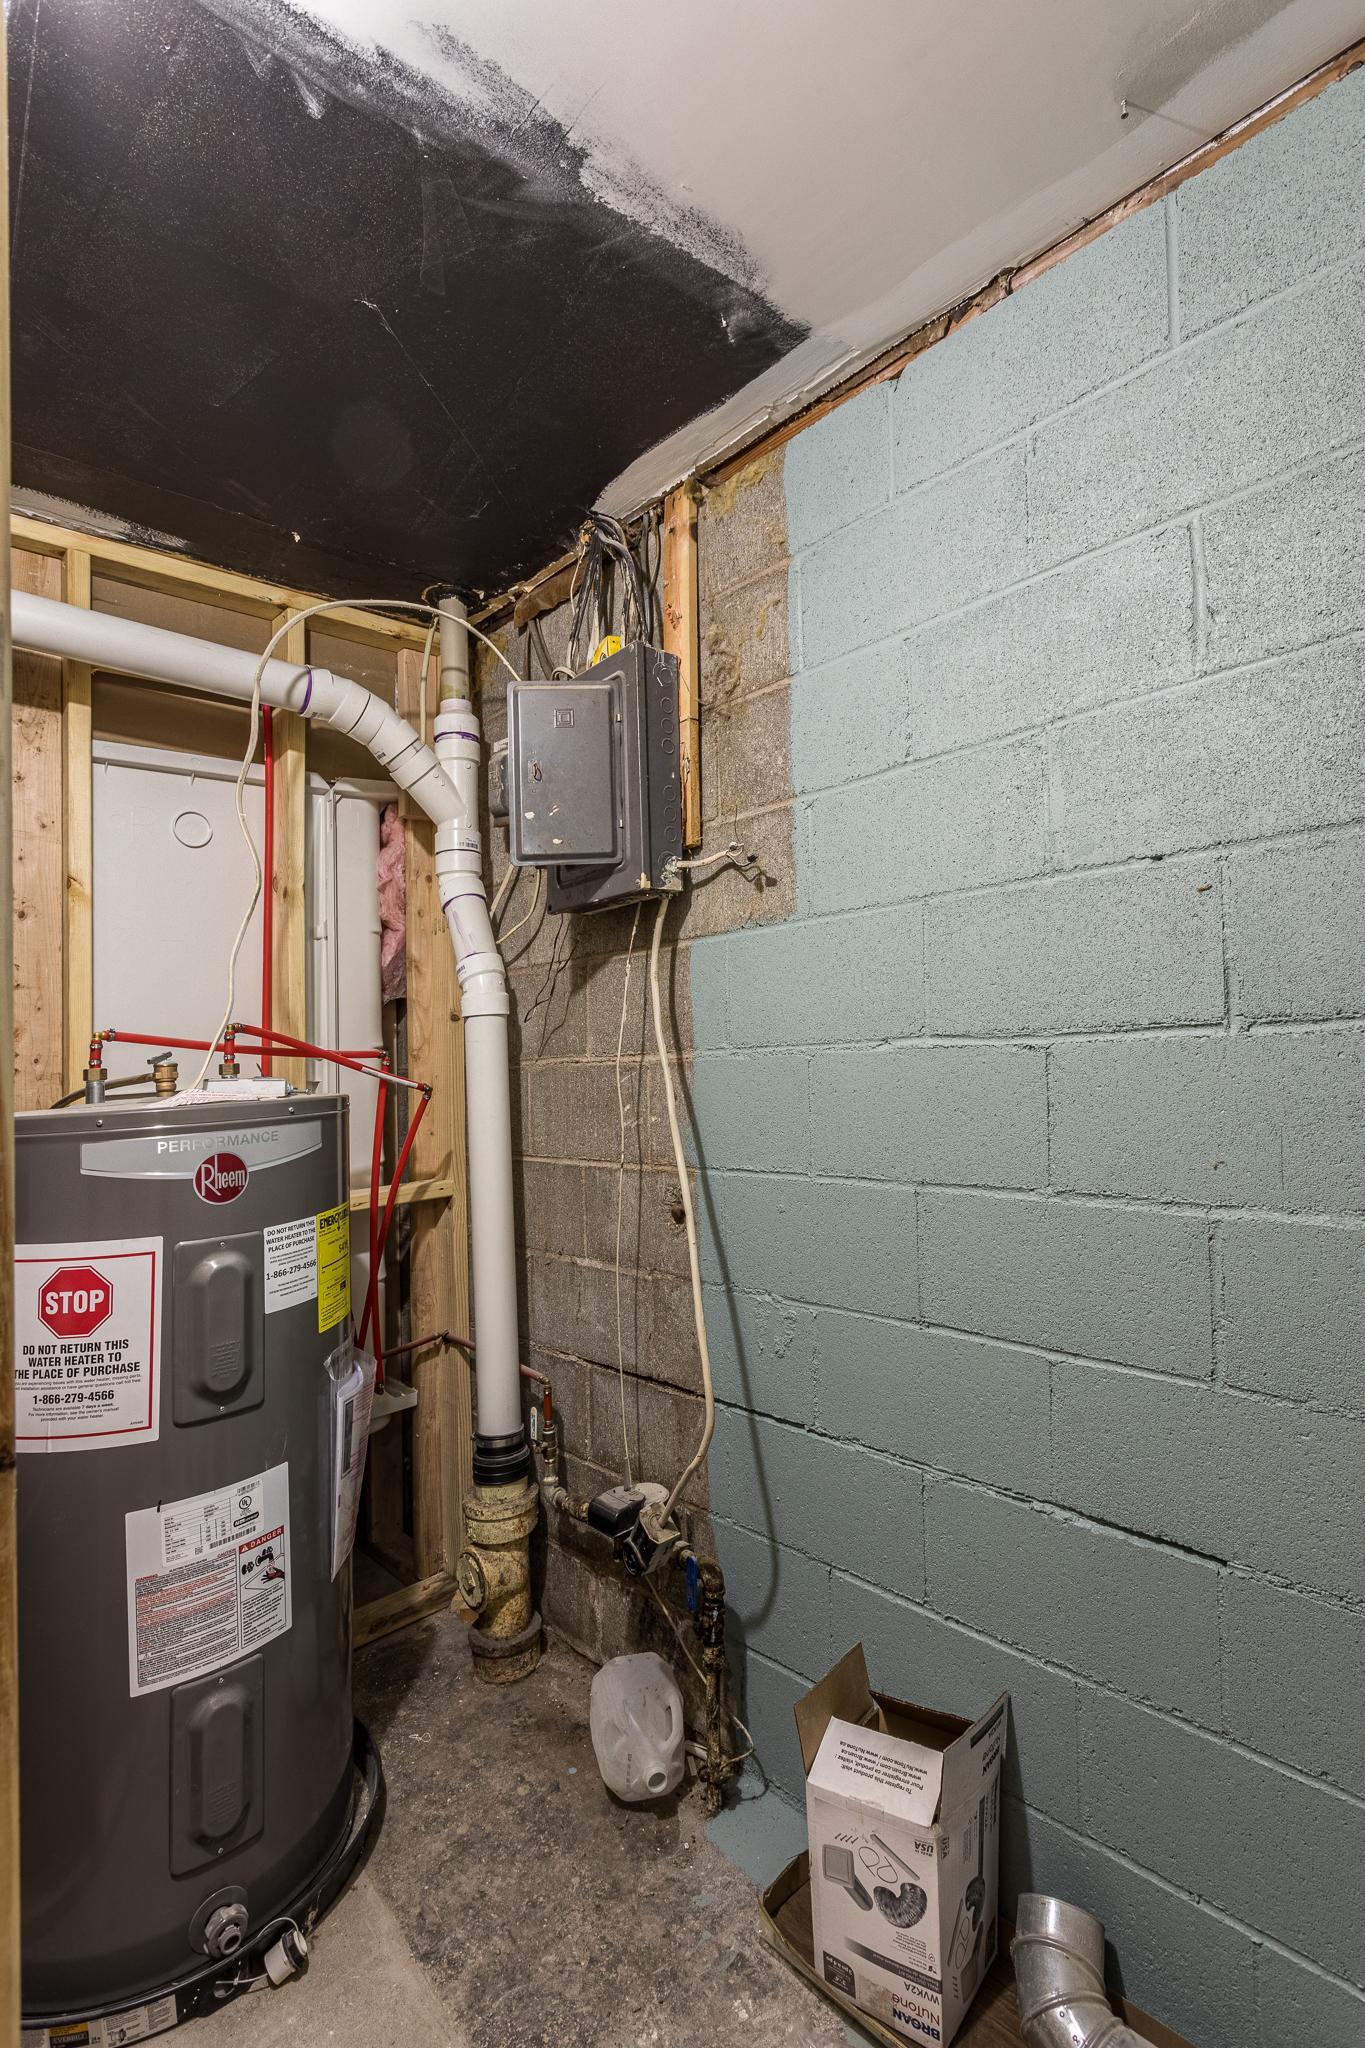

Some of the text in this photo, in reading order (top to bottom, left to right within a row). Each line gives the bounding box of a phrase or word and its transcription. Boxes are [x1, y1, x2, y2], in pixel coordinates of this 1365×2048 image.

[157, 1131, 279, 1154] PERFORMANCE
[201, 1155, 245, 1196] Rheem
[277, 1227, 287, 1235] NOT
[288, 1223, 305, 1232] RETURN
[266, 1236, 284, 1245] WATER
[284, 1232, 302, 1241] HEATER
[268, 1244, 284, 1253] PLACE
[293, 1235, 314, 1247] PURCHASE
[266, 1260, 316, 1281] 1-866-279-4566
[45, 1290, 104, 1315] STOP
[23, 1339, 129, 1355] DO NOT RETURN THIS
[28, 1352, 122, 1367] WATER HEATER TO
[33, 1368, 63, 1379] PLACE
[67, 1368, 79, 1378] OF
[83, 1362, 140, 1377] PURCHASE
[33, 1390, 114, 1404] 1-866-279-4566
[250, 1528, 282, 1548] DANGER
[840, 1741, 878, 1759] www.NuTone.ca
[841, 1749, 876, 1765] www.Broan.ca
[880, 1762, 922, 1781] www.Broan.com
[882, 1755, 928, 1775] www.NuTone.com
[854, 1769, 873, 1780] product
[882, 1771, 910, 1786] enregistrer
[884, 1780, 905, 1793] register
[911, 1781, 924, 1790] Pour
[914, 1841, 933, 1853] USA
[904, 1981, 939, 2005] WVK2A
[892, 1993, 940, 2026] NuTone
[893, 2008, 940, 2041] BROAN
